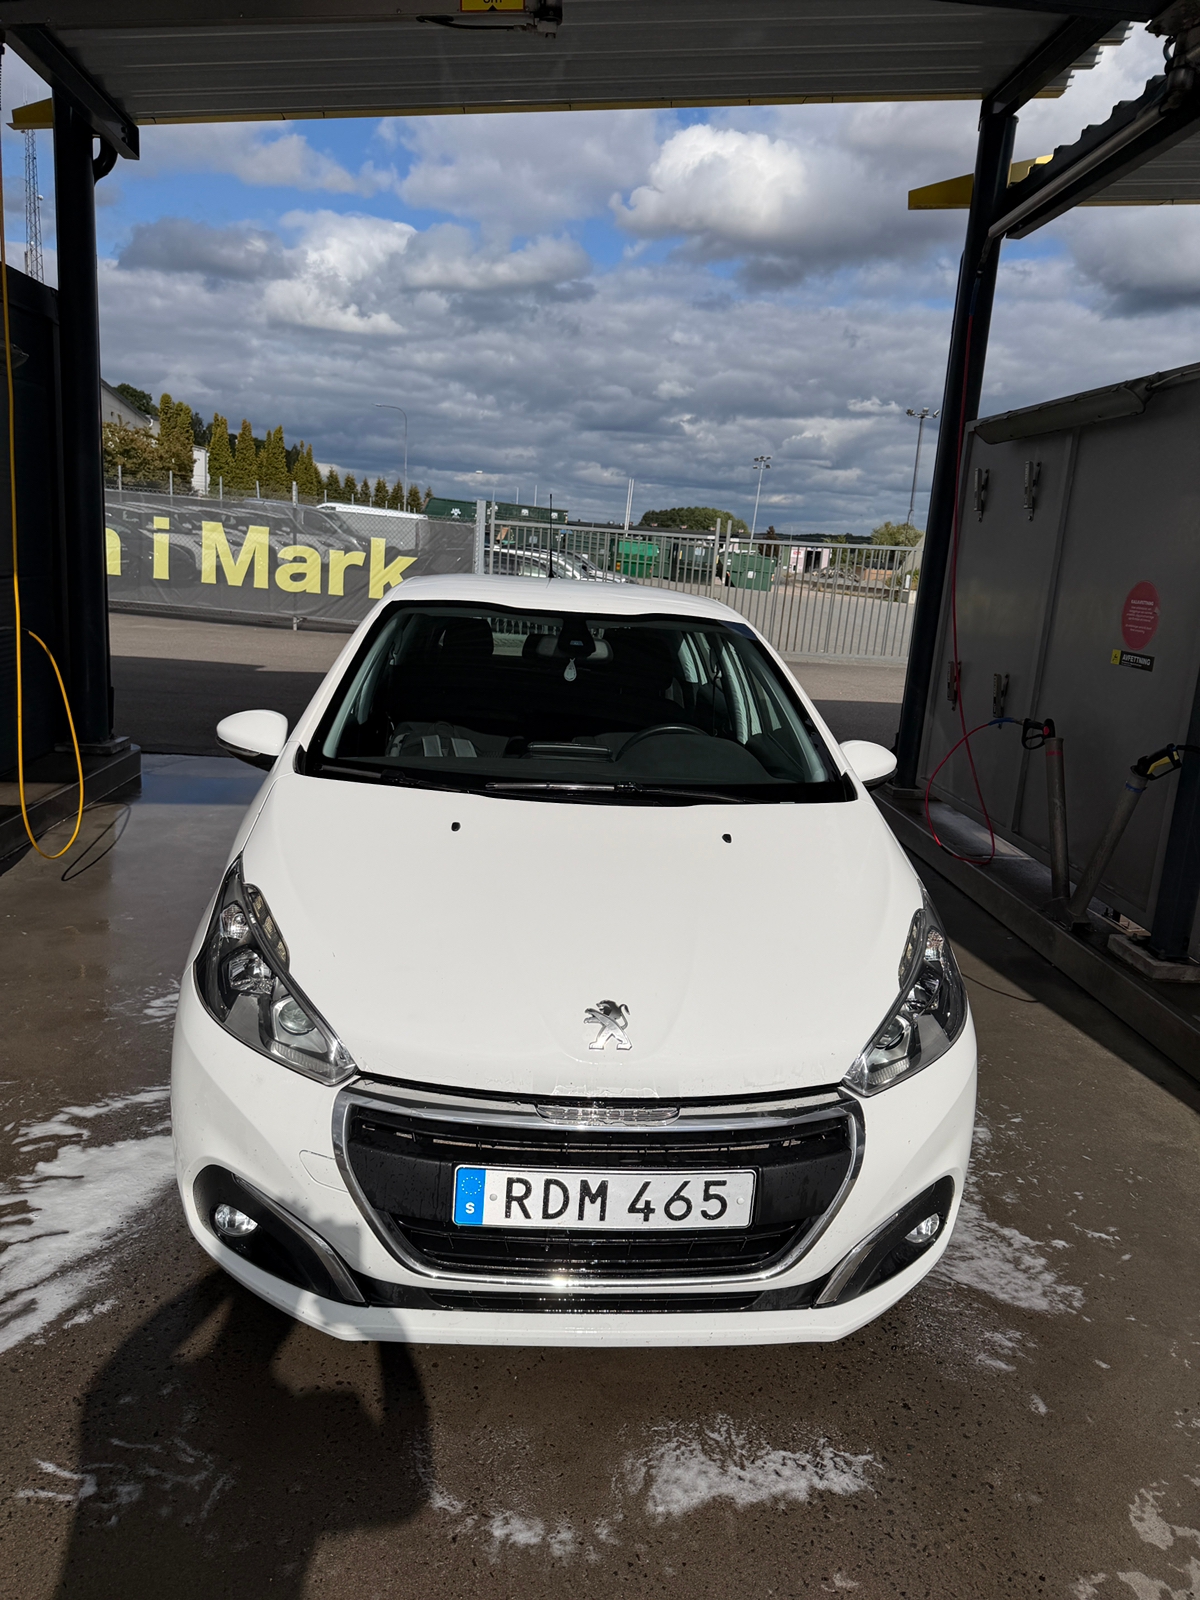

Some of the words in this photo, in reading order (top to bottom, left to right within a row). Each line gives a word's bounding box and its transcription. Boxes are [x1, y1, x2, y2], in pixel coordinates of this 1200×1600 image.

[153, 516, 169, 580] i
[201, 521, 418, 599] Mark
[465, 1202, 475, 1214] S
[504, 1177, 609, 1221] RDM
[627, 1180, 728, 1222] 465
